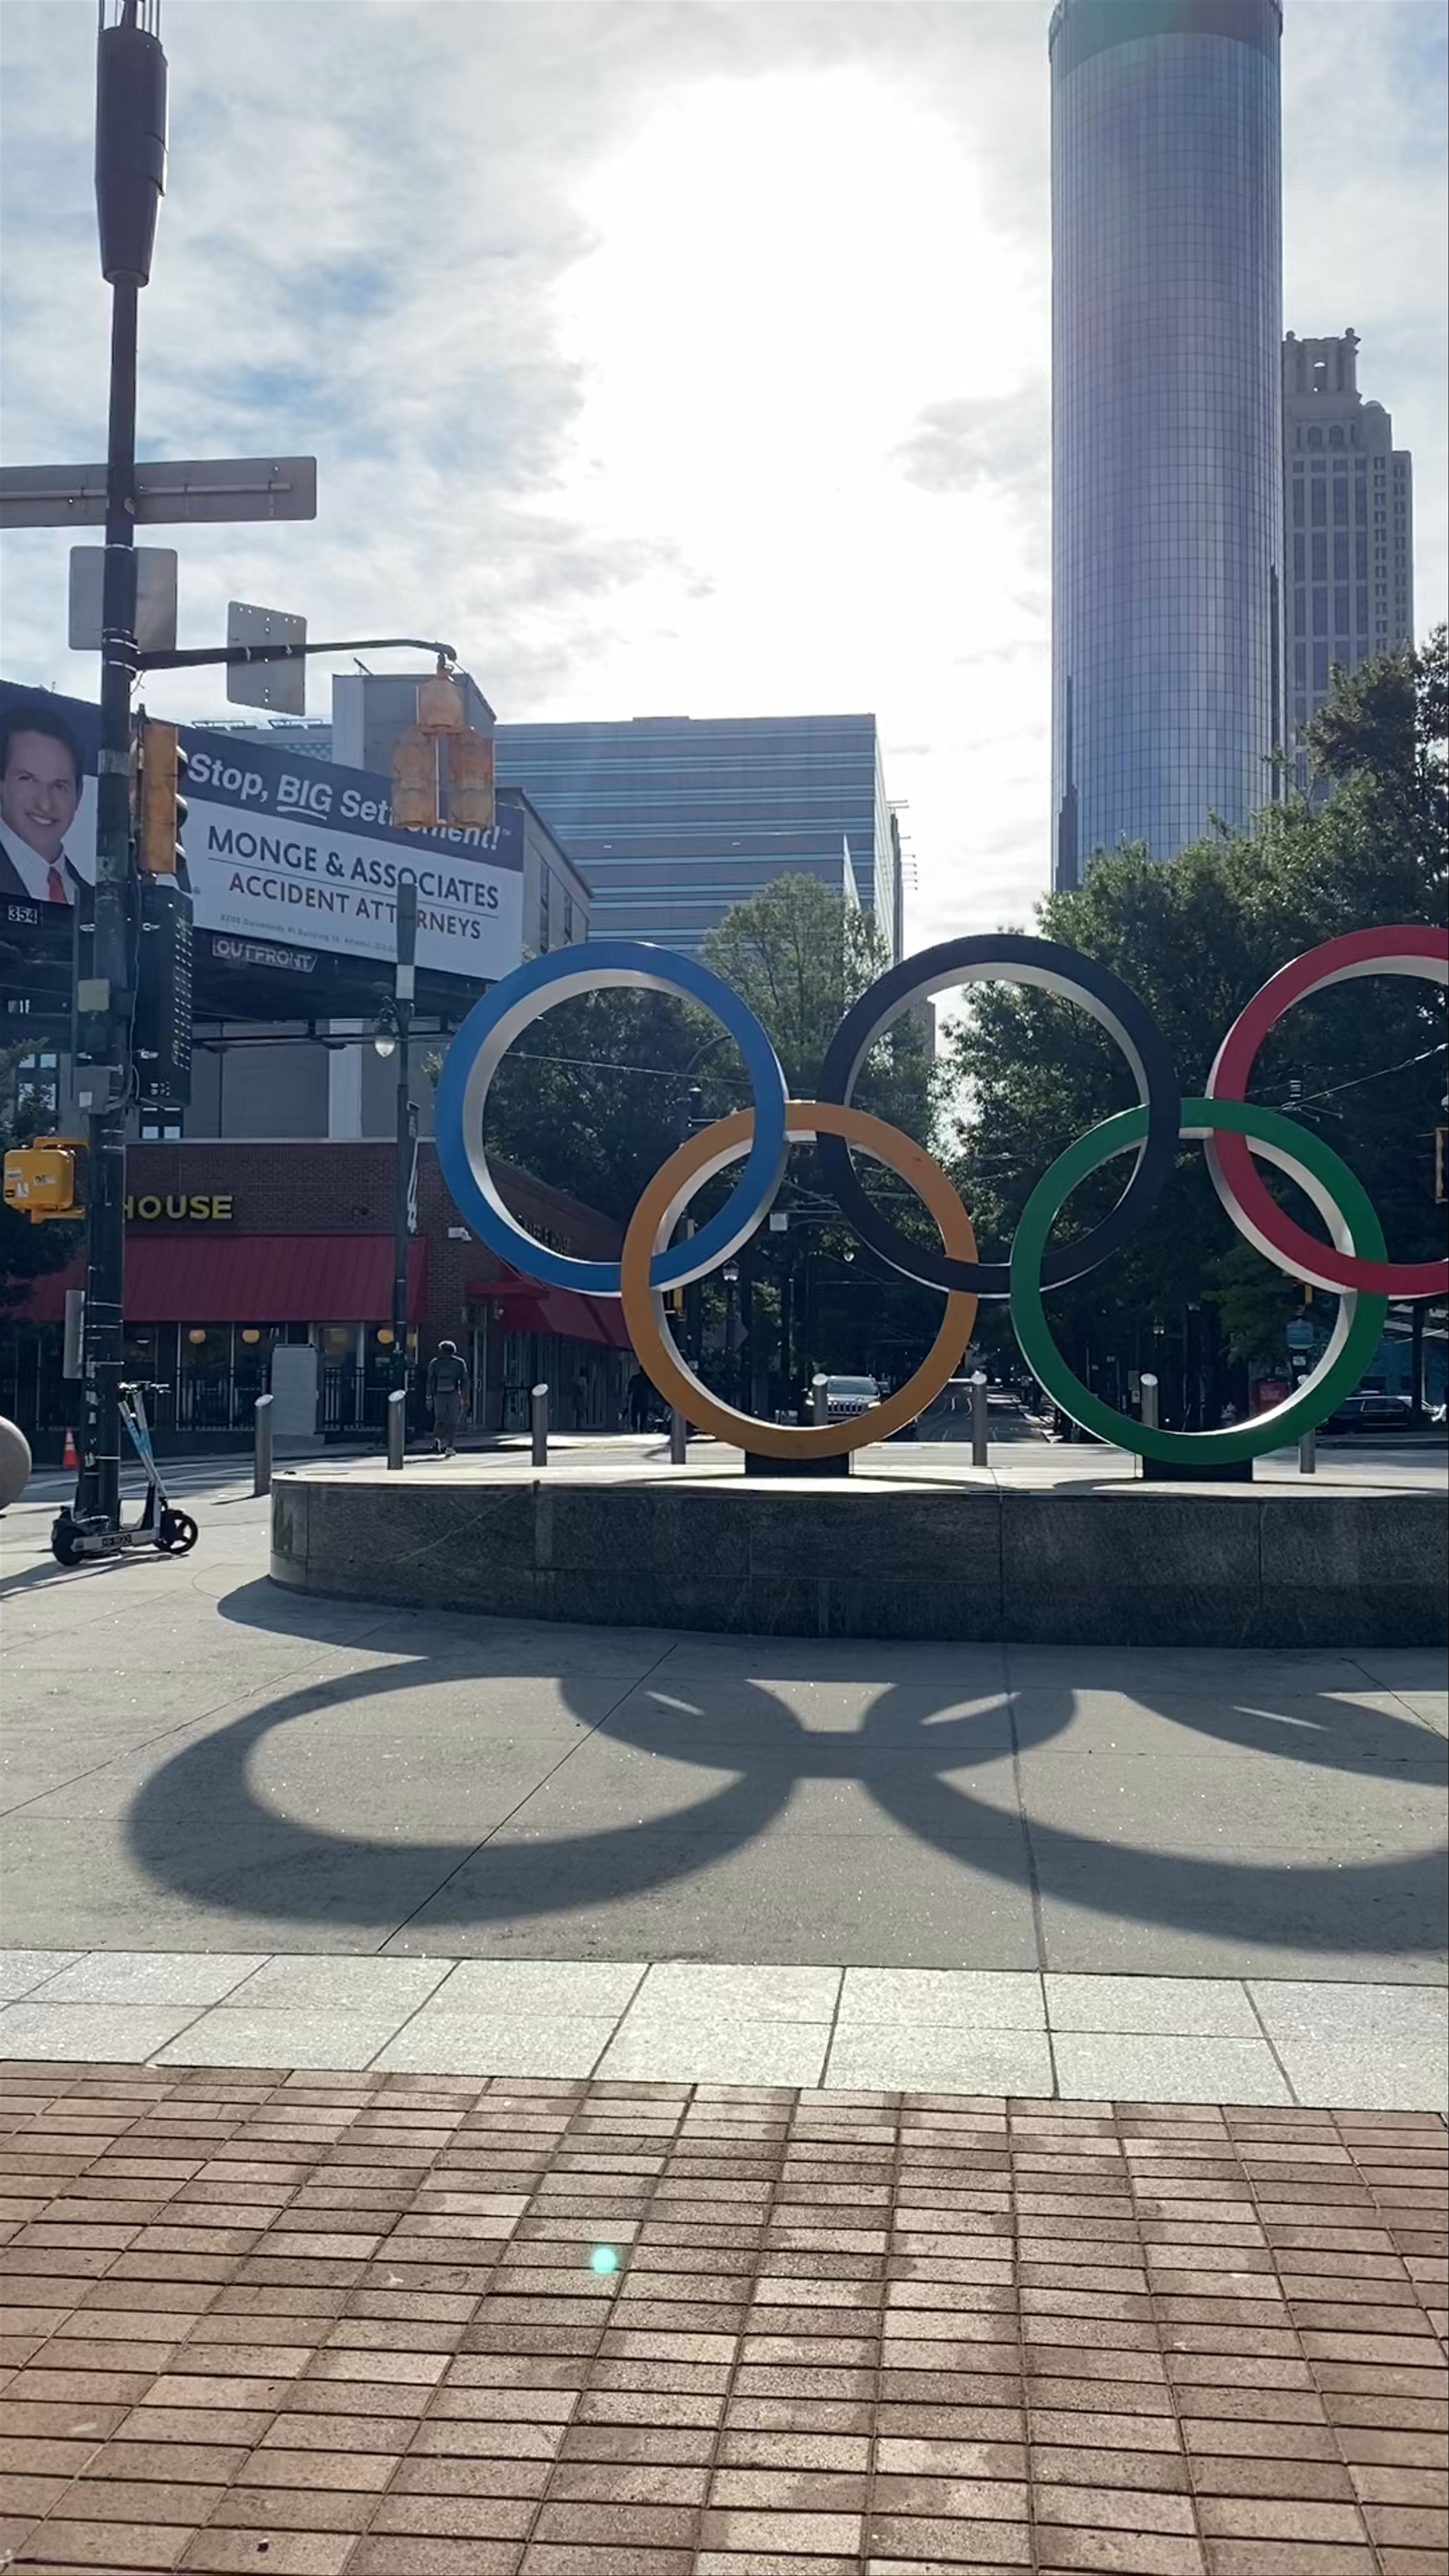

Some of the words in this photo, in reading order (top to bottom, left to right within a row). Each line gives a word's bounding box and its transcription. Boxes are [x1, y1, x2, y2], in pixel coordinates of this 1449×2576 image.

[189, 753, 268, 803] Stop,
[277, 775, 332, 813] BIG
[208, 826, 317, 872] MONGE
[326, 852, 345, 878] &
[351, 857, 498, 909] ASSOCIATES
[229, 872, 349, 914] ACCIDENT
[355, 897, 481, 939] ATTRNEYS
[217, 940, 312, 968] OUTFRONT
